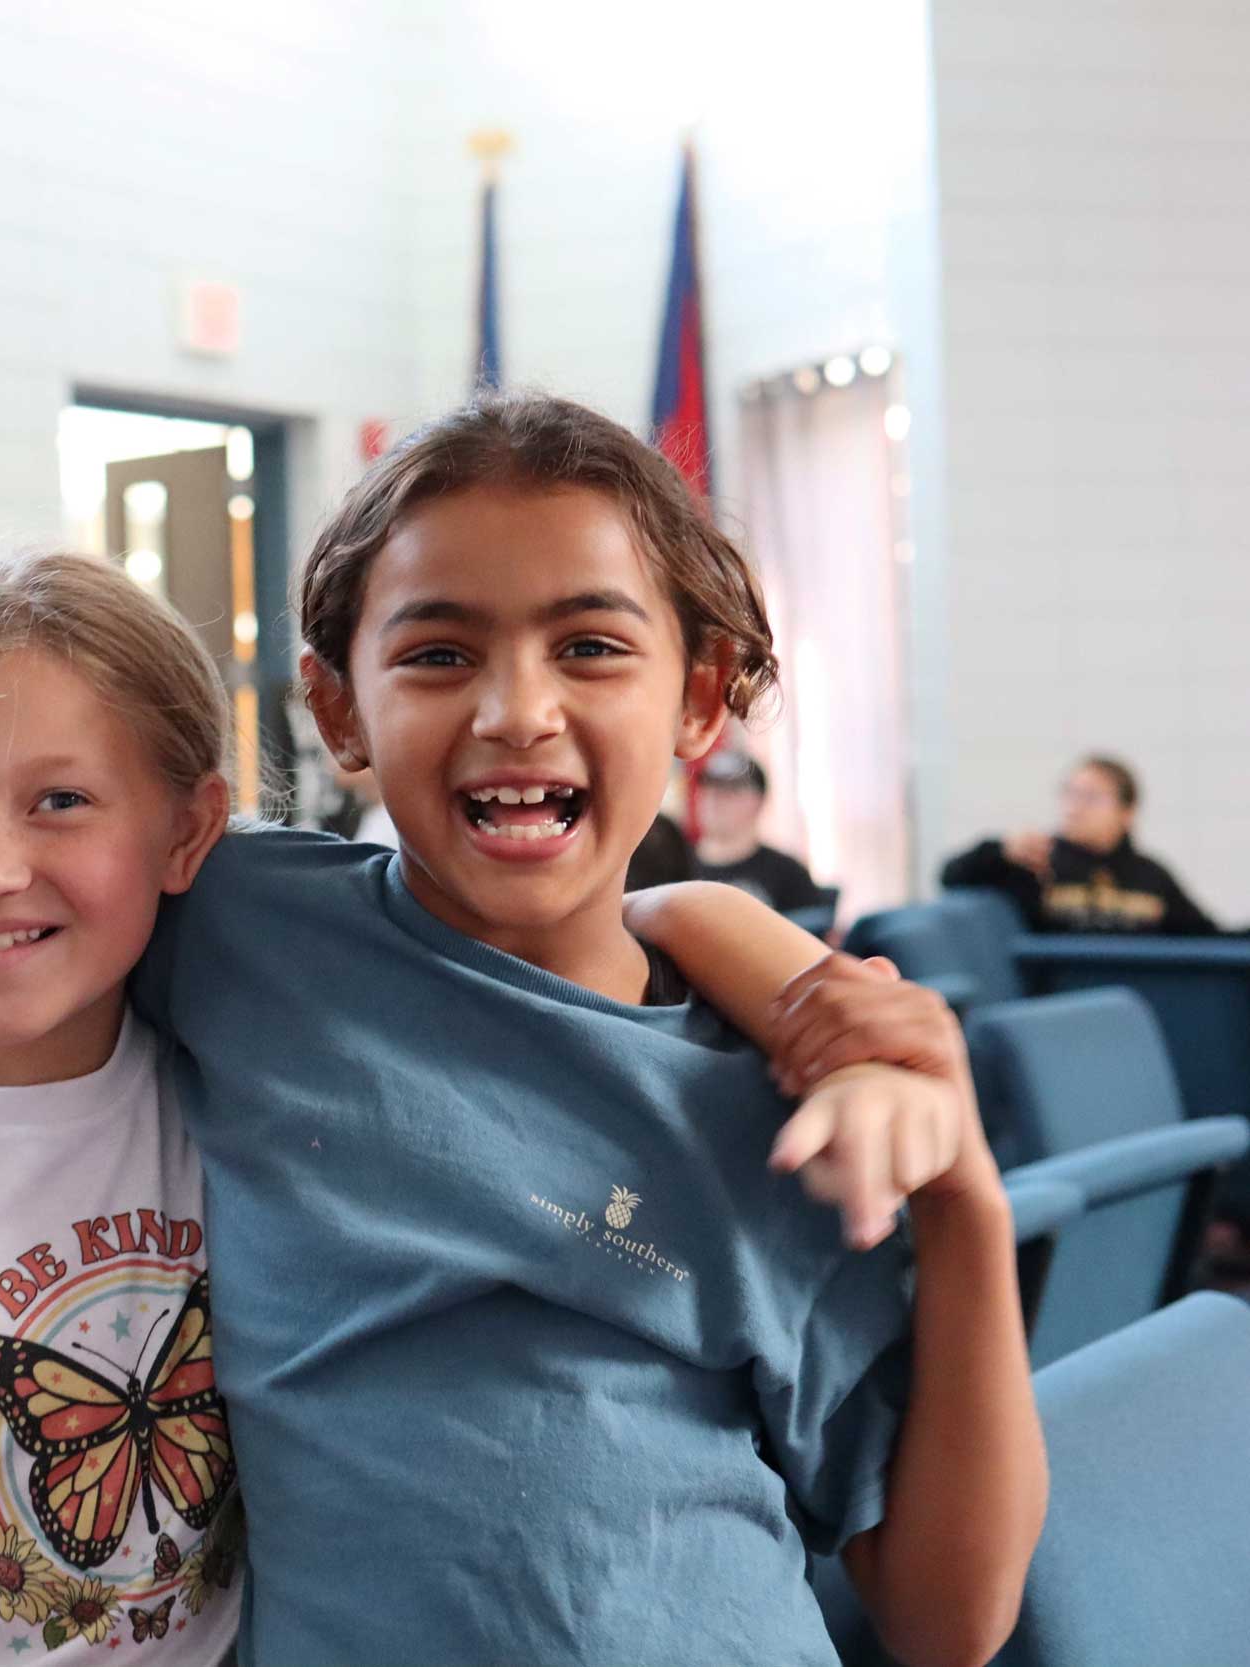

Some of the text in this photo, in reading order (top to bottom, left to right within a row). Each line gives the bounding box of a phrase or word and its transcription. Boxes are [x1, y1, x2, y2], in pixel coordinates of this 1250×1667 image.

[72, 1208, 203, 1266] KIND
[529, 1193, 686, 1282] simply southern
